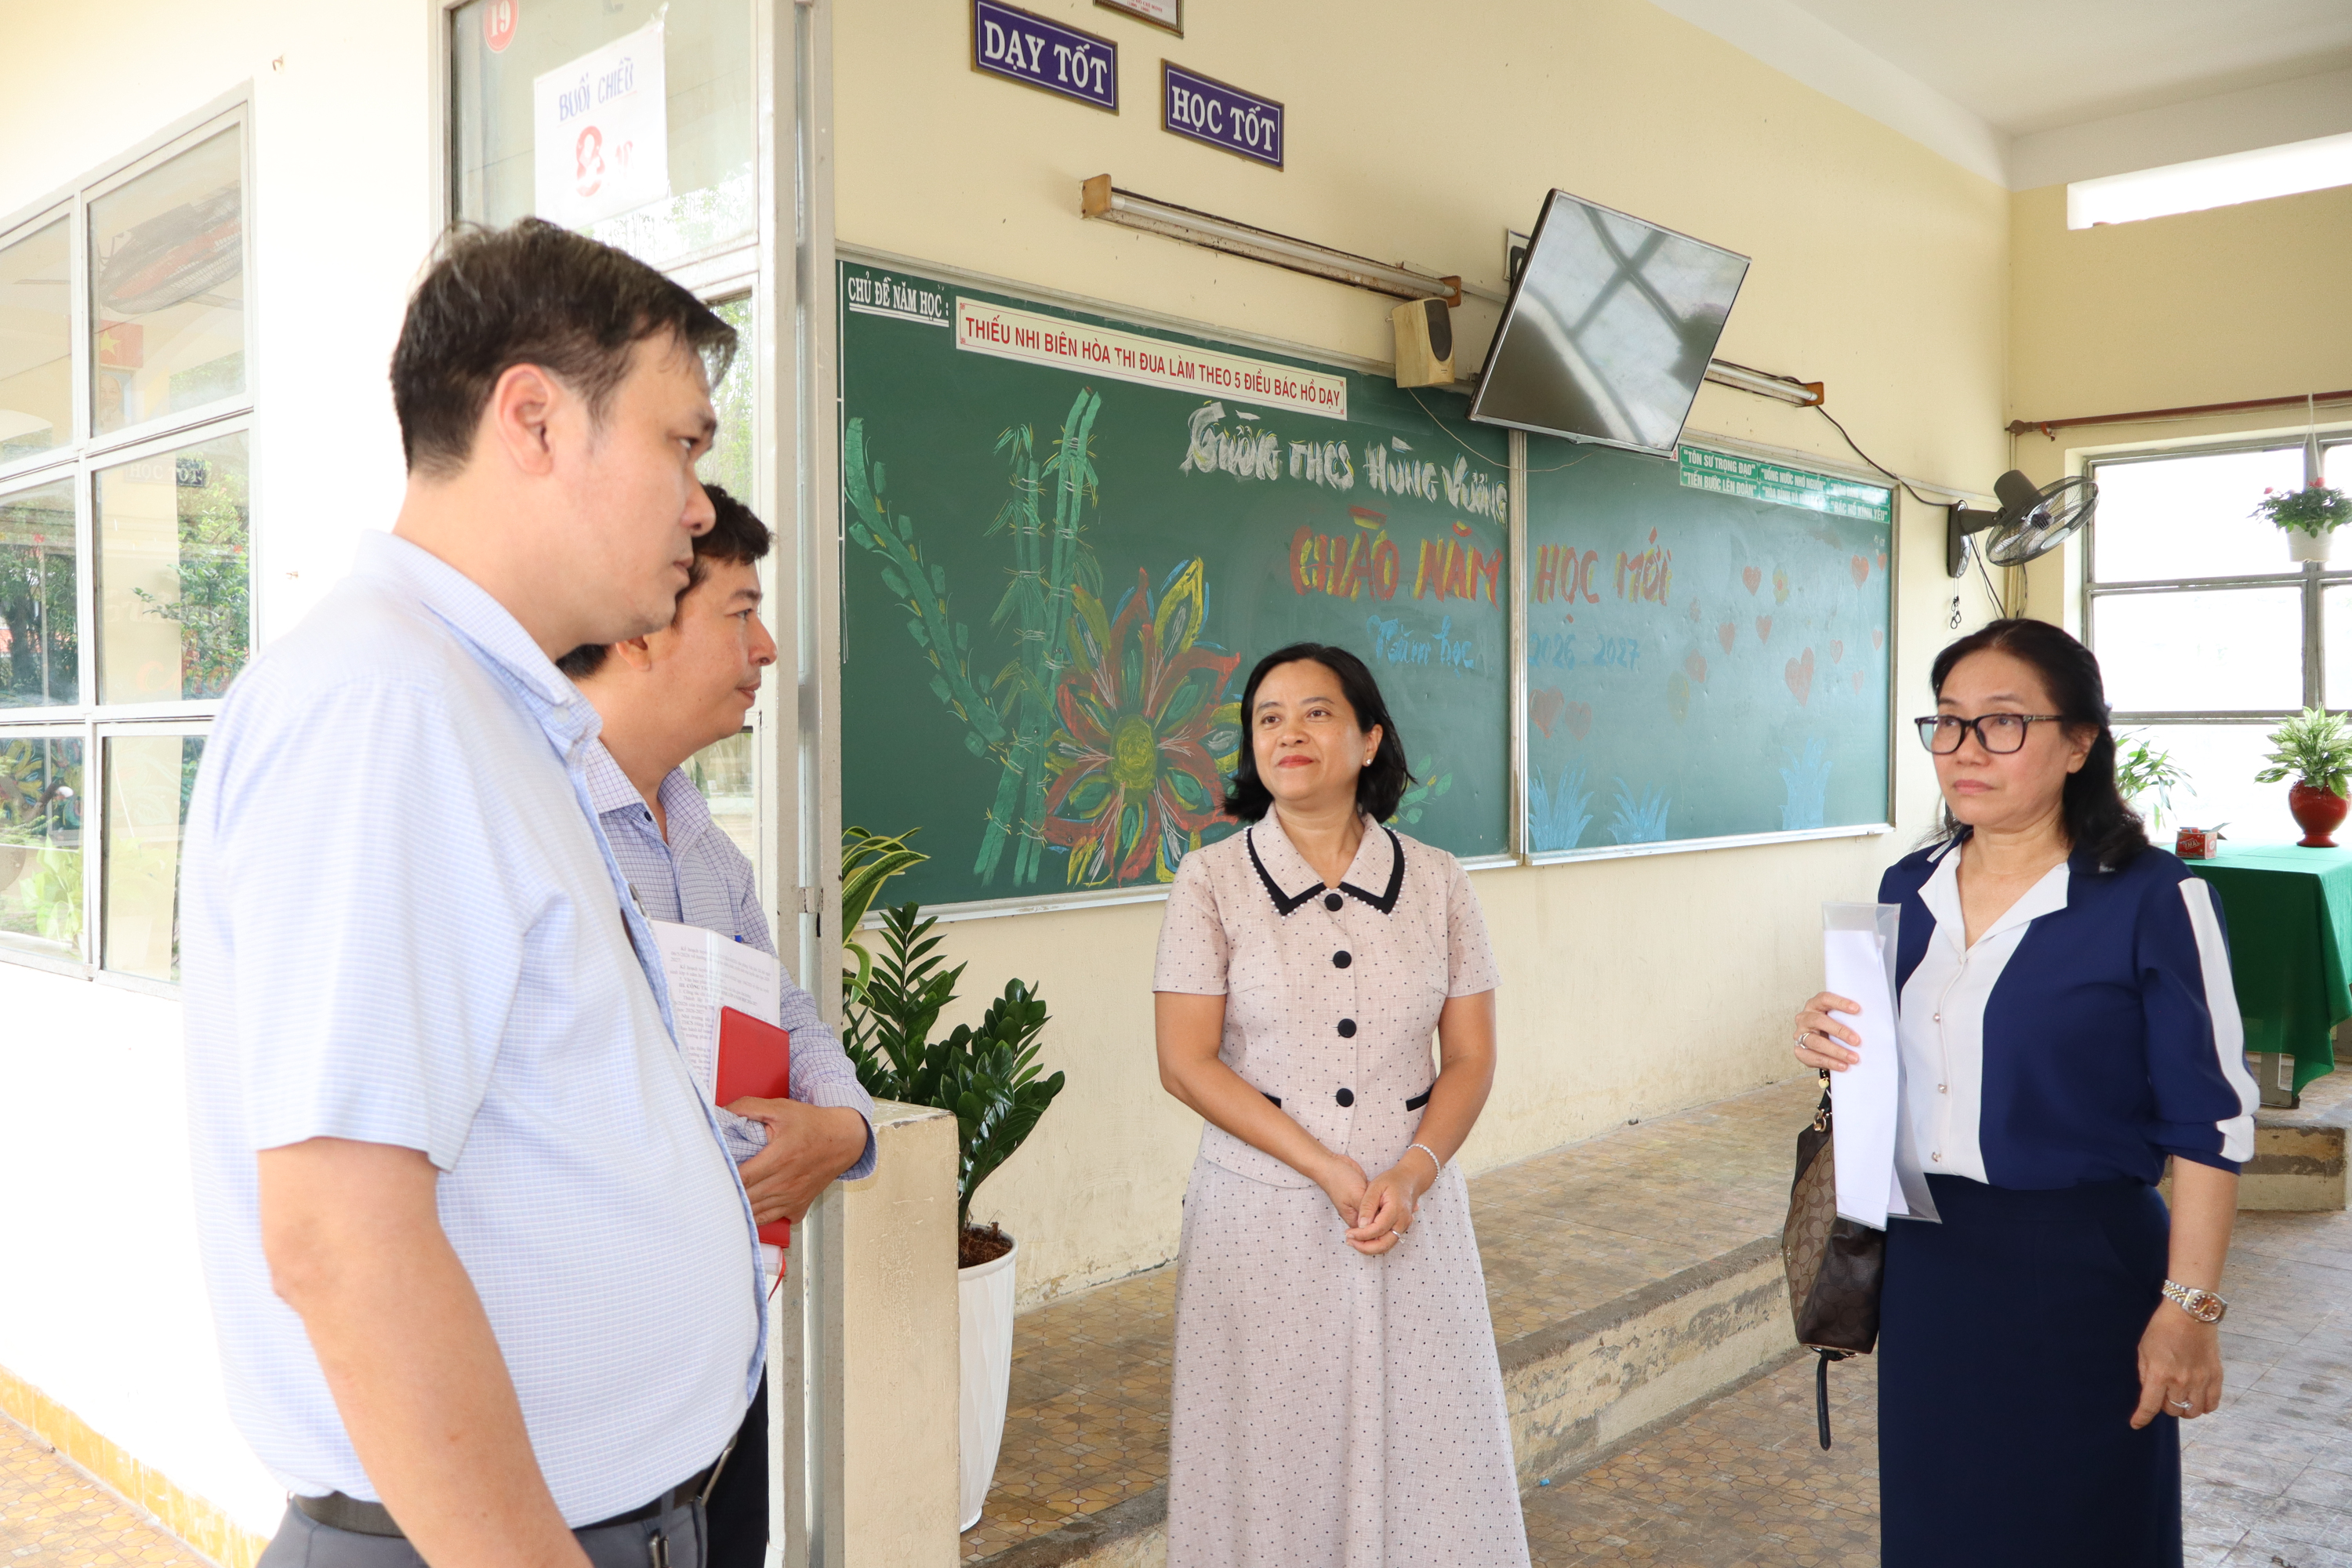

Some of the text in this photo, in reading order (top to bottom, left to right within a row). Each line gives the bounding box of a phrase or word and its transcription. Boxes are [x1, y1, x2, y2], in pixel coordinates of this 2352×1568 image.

[490, 0, 511, 37] 19
[559, 56, 633, 122] BUỔI CHIỀU
[984, 20, 1108, 95] DẠY TỐT
[1171, 85, 1276, 152] HỌC TỐT
[848, 270, 872, 304] CHỦ
[874, 276, 891, 307] ĐỀ
[893, 281, 917, 313] NĂM
[920, 291, 942, 321] HỌC
[966, 314, 1340, 409] THIẾU NHI BIÊN HÒA THI ĐUA LÀM THEO 5 ĐIỀU BÁC HỒ DẠY
[1288, 441, 1354, 491] THCS
[1704, 455, 1714, 467] SƯ
[1715, 457, 1737, 474] TRỌNG
[1722, 477, 1735, 493] LÊN
[1290, 504, 1672, 623] CHÀO NĂM HỌC MỚI
[1432, 615, 1474, 678] học
